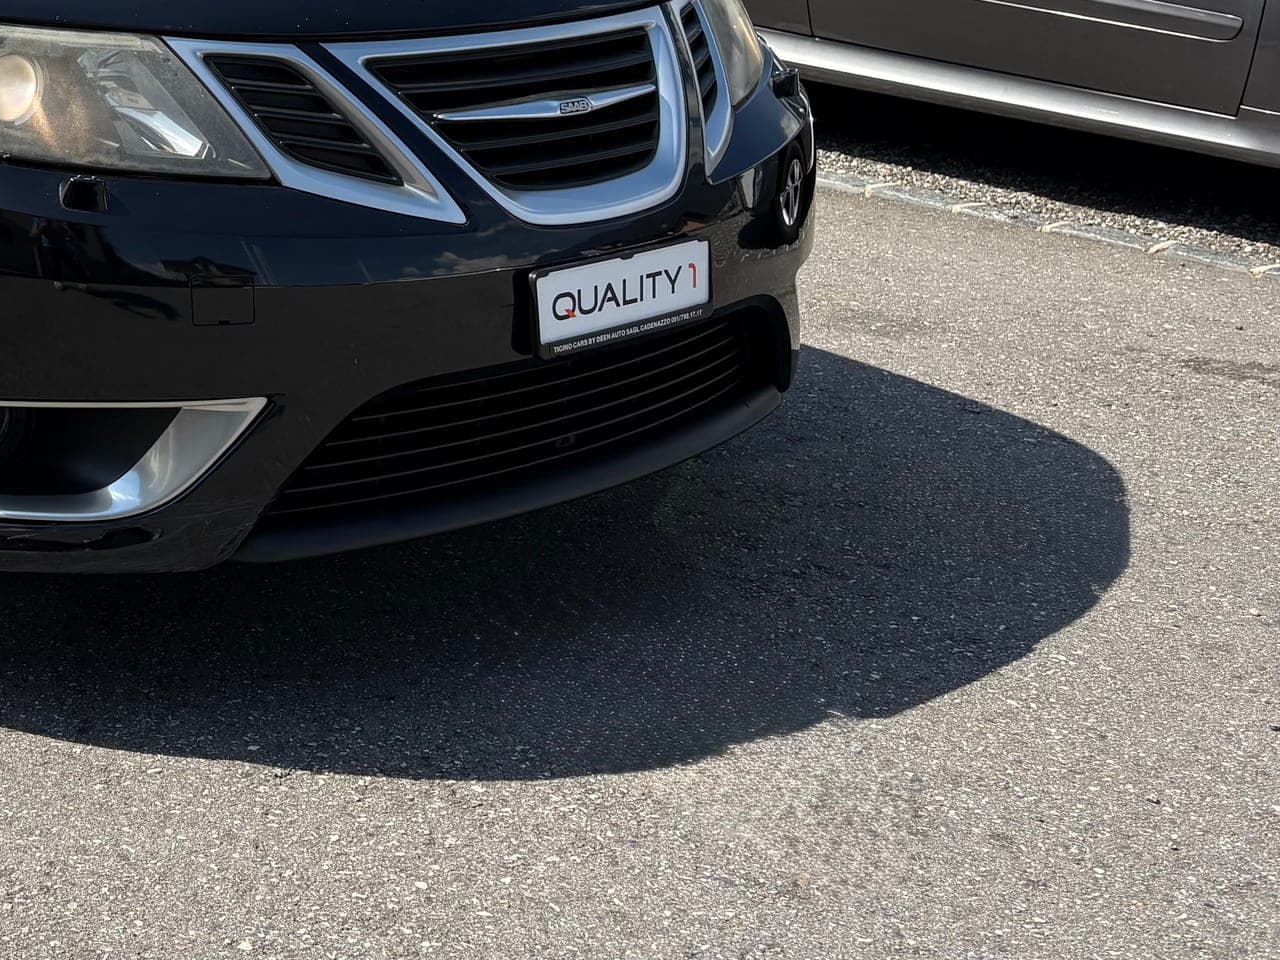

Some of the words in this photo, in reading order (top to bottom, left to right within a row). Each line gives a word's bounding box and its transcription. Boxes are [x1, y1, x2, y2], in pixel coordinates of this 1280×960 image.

[560, 100, 589, 113] SAAB
[553, 342, 573, 353] TICINO
[573, 339, 588, 349] CARS
[611, 330, 625, 339] AUTO
